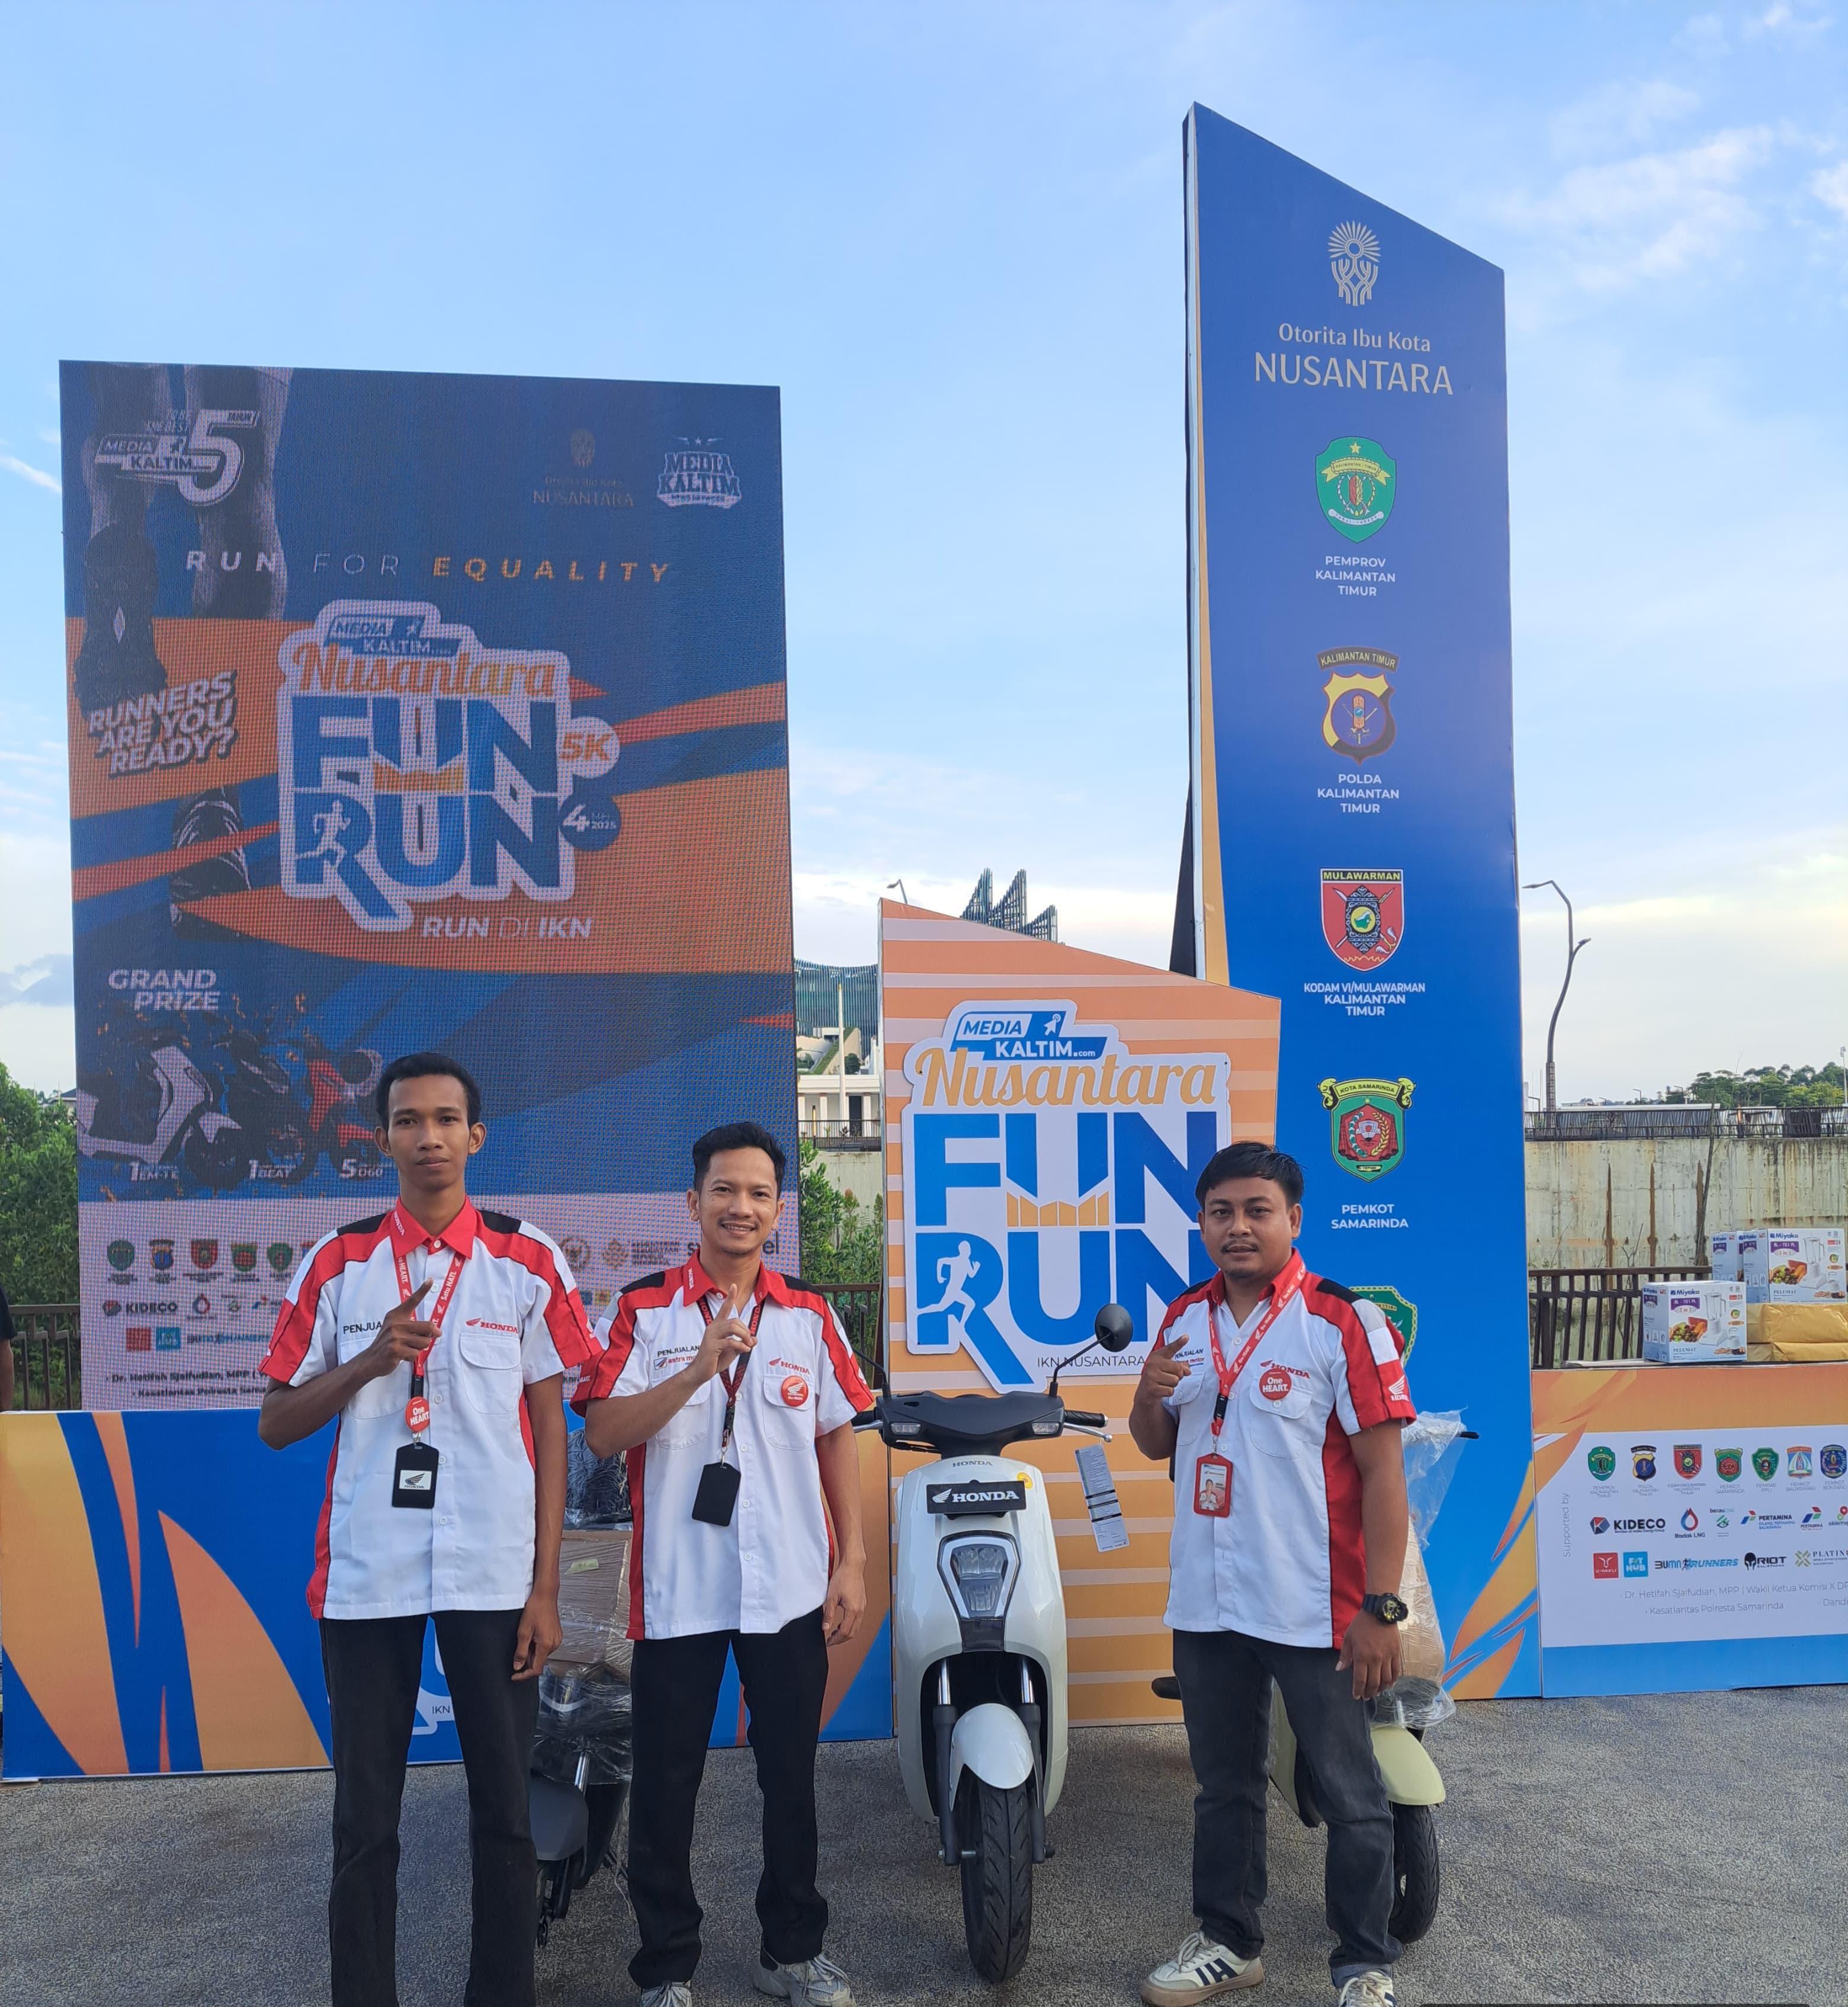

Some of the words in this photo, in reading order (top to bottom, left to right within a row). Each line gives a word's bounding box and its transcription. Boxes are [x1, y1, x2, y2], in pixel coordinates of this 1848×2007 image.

[1279, 323, 1346, 346] Otorita
[1353, 328, 1383, 348] Ibu
[1388, 332, 1430, 352] Kota
[1254, 352, 1454, 395] NUSANTARA
[104, 440, 153, 453] MEDIA
[657, 473, 740, 496] KALTIM
[186, 550, 277, 572] RUN
[313, 552, 399, 575] FOR
[432, 556, 669, 583] EQUALITY
[1324, 556, 1386, 568] PEMPROV
[1315, 569, 1396, 583] KALIMANTAN
[1337, 584, 1377, 597] TIMUR
[1320, 651, 1370, 666] KALIMANTAN
[1372, 653, 1396, 668] TIMUR
[292, 642, 556, 696] Nusantara
[89, 671, 235, 735] RUNNERS
[98, 720, 154, 751] ARE
[161, 697, 236, 740] YOU
[110, 726, 236, 774] READY?
[291, 695, 557, 792] FUN
[559, 732, 614, 761] 5K
[1338, 774, 1382, 784] POLDA
[1317, 788, 1400, 799] KALIMANTAN
[1340, 803, 1381, 813] TIMUR
[562, 804, 591, 832] 4
[591, 820, 617, 830] 2025
[295, 792, 560, 919] RUN
[1323, 872, 1401, 880] MULAWARMAN
[422, 916, 490, 938] RUN
[500, 918, 529, 938] DI
[538, 917, 592, 938] IKN
[108, 969, 217, 990] GRAND
[1304, 983, 1340, 993] KODAM
[1342, 982, 1426, 993] VI/MULAWARMAN
[134, 990, 221, 1011] PRIZE
[1324, 995, 1406, 1004] KALIMANTAN
[1346, 1006, 1385, 1016] TIMUR
[962, 1020, 1022, 1035] MEDIA
[915, 1047, 1217, 1107] Nusantara
[1340, 1085, 1357, 1094] KOTA
[1358, 1084, 1395, 1093] SAMARINDA
[913, 1111, 1217, 1226] FUN
[1342, 1204, 1395, 1214] PEMKOT
[1331, 1218, 1409, 1229] SAMARINDA
[441, 1285, 451, 1301] Satu
[126, 1302, 178, 1315] KIDECO
[915, 1228, 1218, 1385] RUN
[343, 1321, 383, 1335] PENJUA
[480, 1322, 518, 1333] HONDA
[657, 1345, 700, 1357] PENJUALAN
[781, 1361, 810, 1375] HONDA
[1037, 1357, 1060, 1368] IKN
[1064, 1355, 1145, 1367] NUSANTARA
[1272, 1363, 1311, 1379] HONDA
[412, 1406, 425, 1416] One
[952, 1490, 1019, 1503] HONDA
[1613, 1518, 1666, 1530] KIDECO
[1561, 1506, 1571, 1559] Supported
[1756, 1556, 1787, 1564] RIOT
[1625, 1564, 1646, 1573] HUB
[1639, 1589, 1670, 1598] Hetifah
[1719, 1586, 1740, 1595] MPP
[1746, 1585, 1770, 1594] Wakil
[1772, 1584, 1797, 1592] Ketua
[1799, 1582, 1827, 1591] Komisi
[1837, 1581, 1848, 1590] DP
[1650, 1606, 1699, 1615] Kasatlantas
[1701, 1604, 1735, 1612] Polresta
[1737, 1602, 1784, 1612] Samarinda
[1823, 1598, 1848, 1607] Dandi
[432, 1705, 451, 1715] IKN
